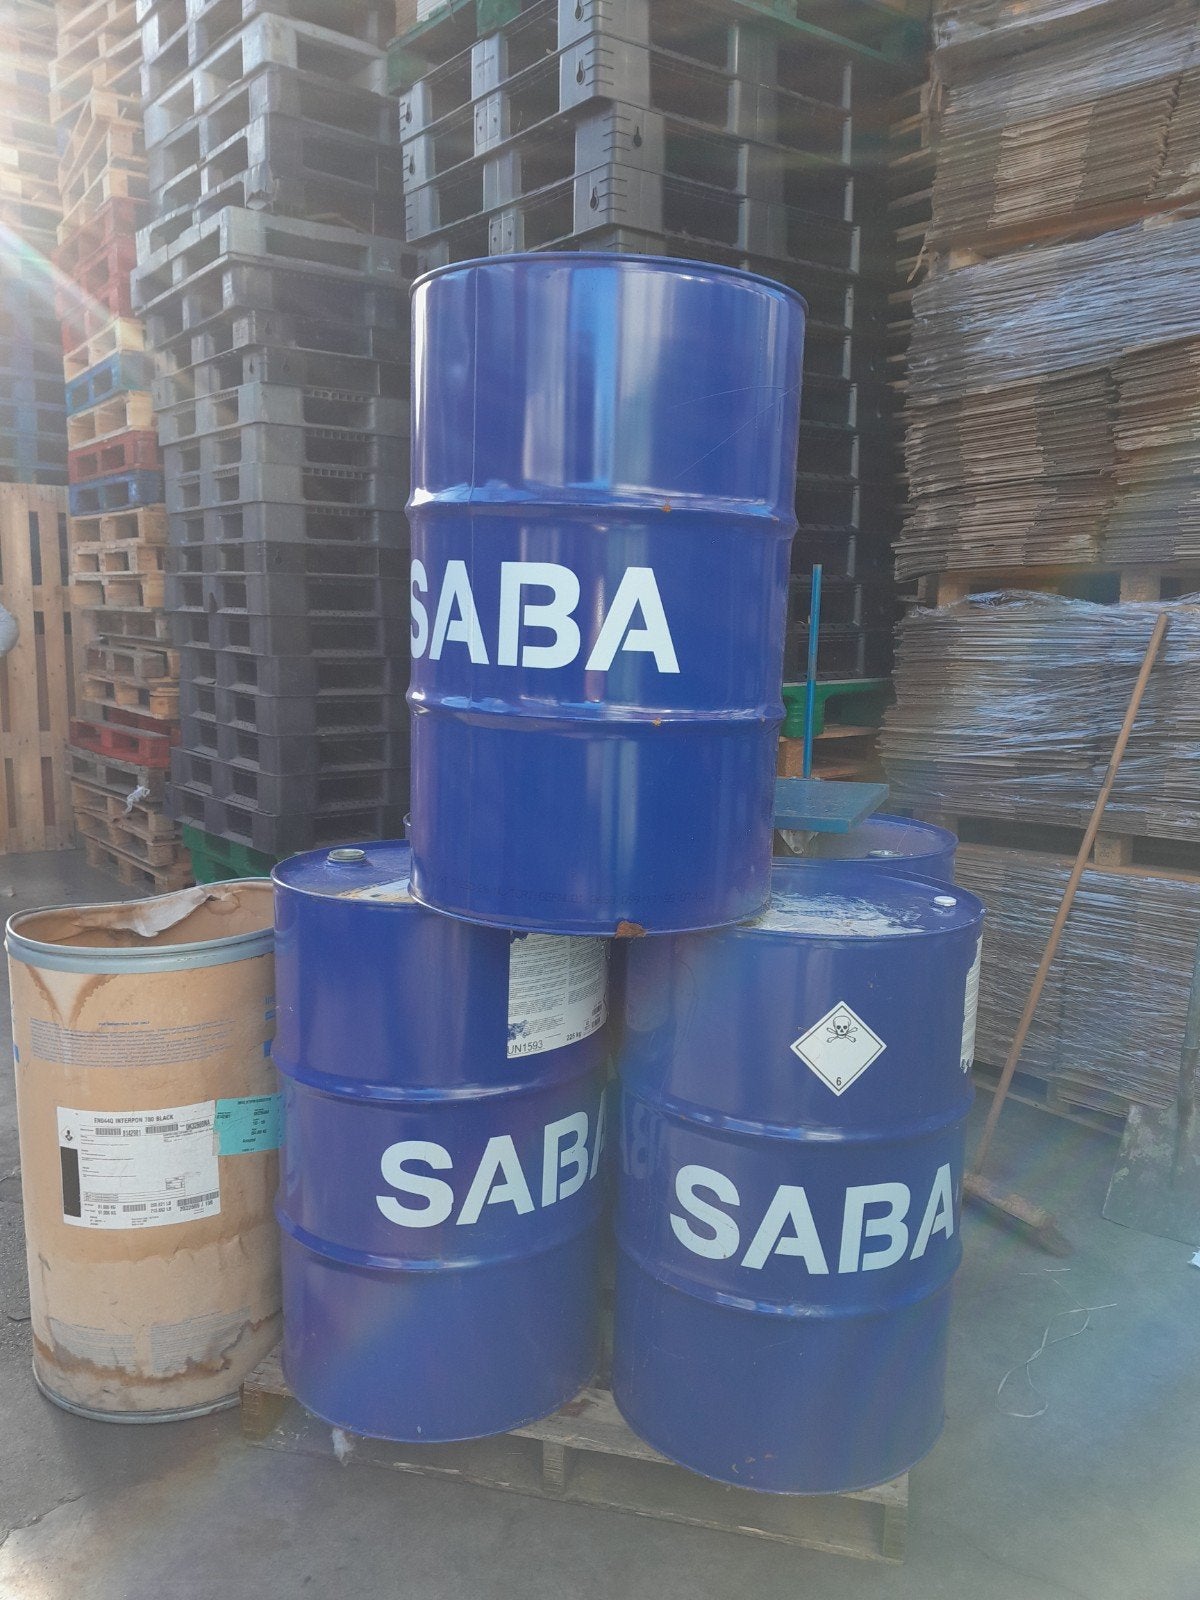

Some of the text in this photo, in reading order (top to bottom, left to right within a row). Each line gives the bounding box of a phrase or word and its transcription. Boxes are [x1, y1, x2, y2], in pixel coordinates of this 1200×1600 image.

[410, 558, 681, 674] SABA
[507, 1039, 544, 1055] UN1593
[836, 1076, 842, 1086] 6
[156, 1114, 174, 1122] BLACK
[669, 1162, 954, 1275] SABA
